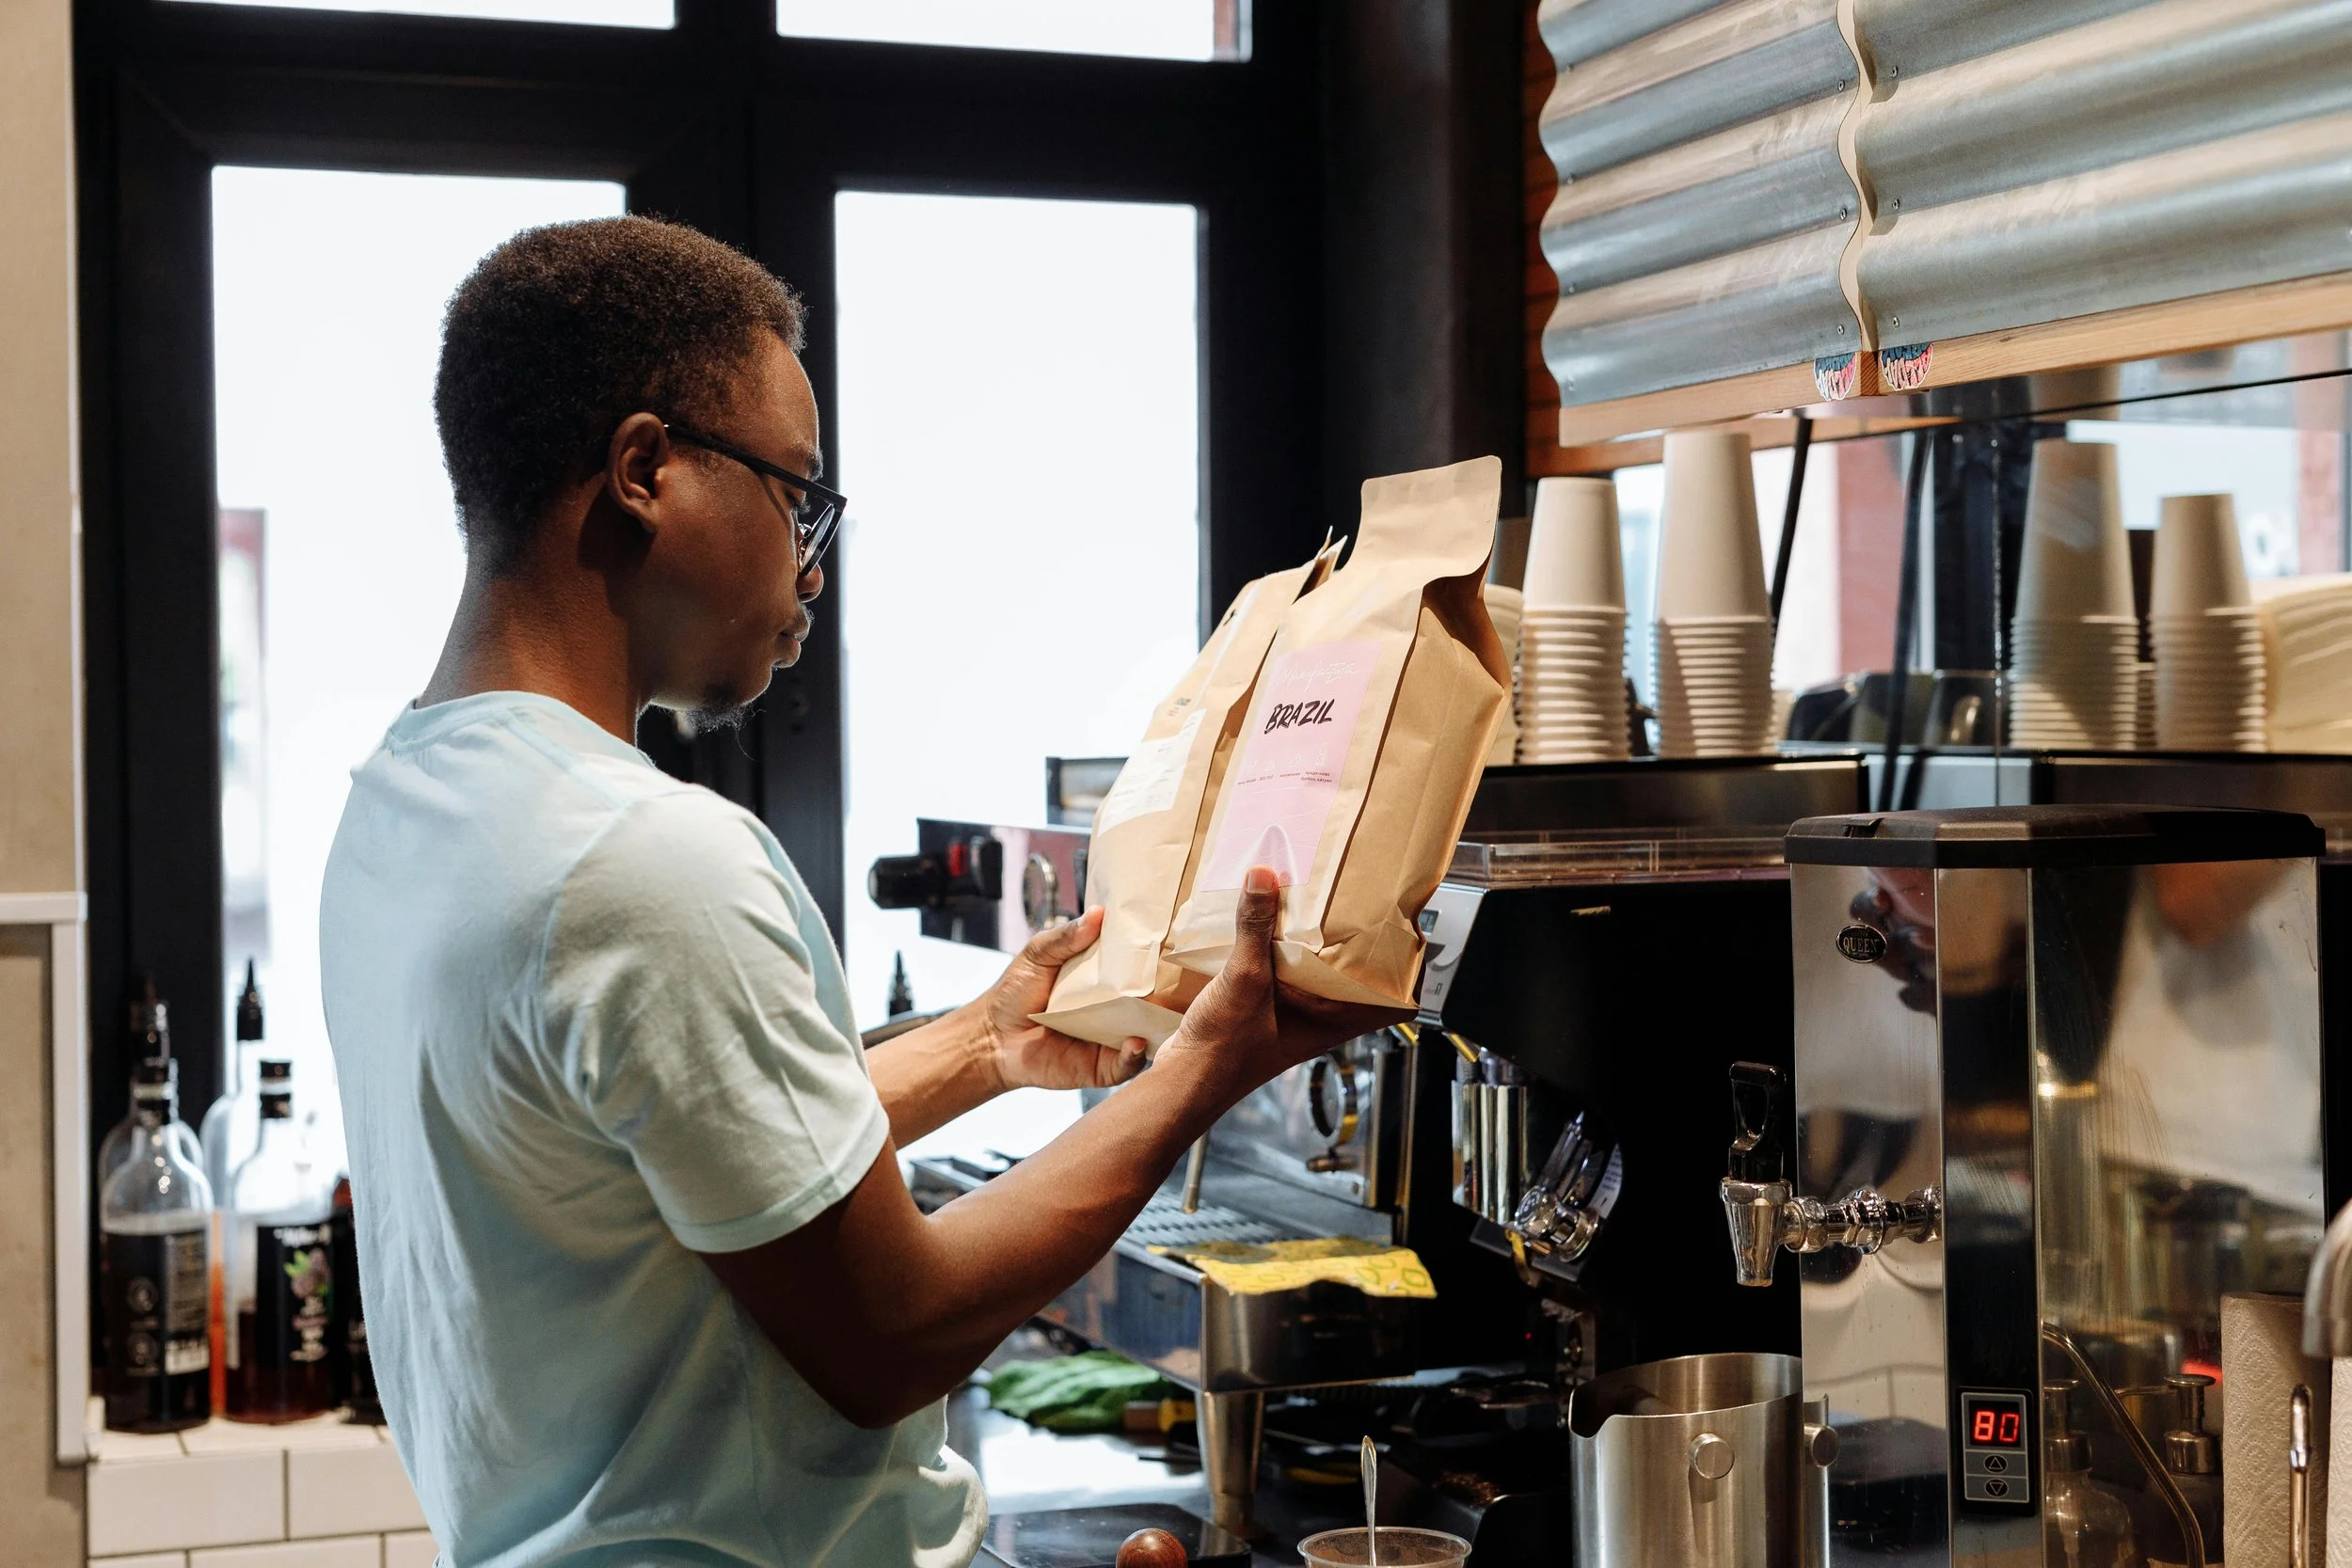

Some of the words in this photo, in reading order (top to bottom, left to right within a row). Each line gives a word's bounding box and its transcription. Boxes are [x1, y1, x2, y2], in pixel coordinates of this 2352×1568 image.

[1264, 699, 1335, 735] BRAZIL
[1843, 936, 1880, 955] QUEEN
[1975, 1411, 2019, 1442] 80
